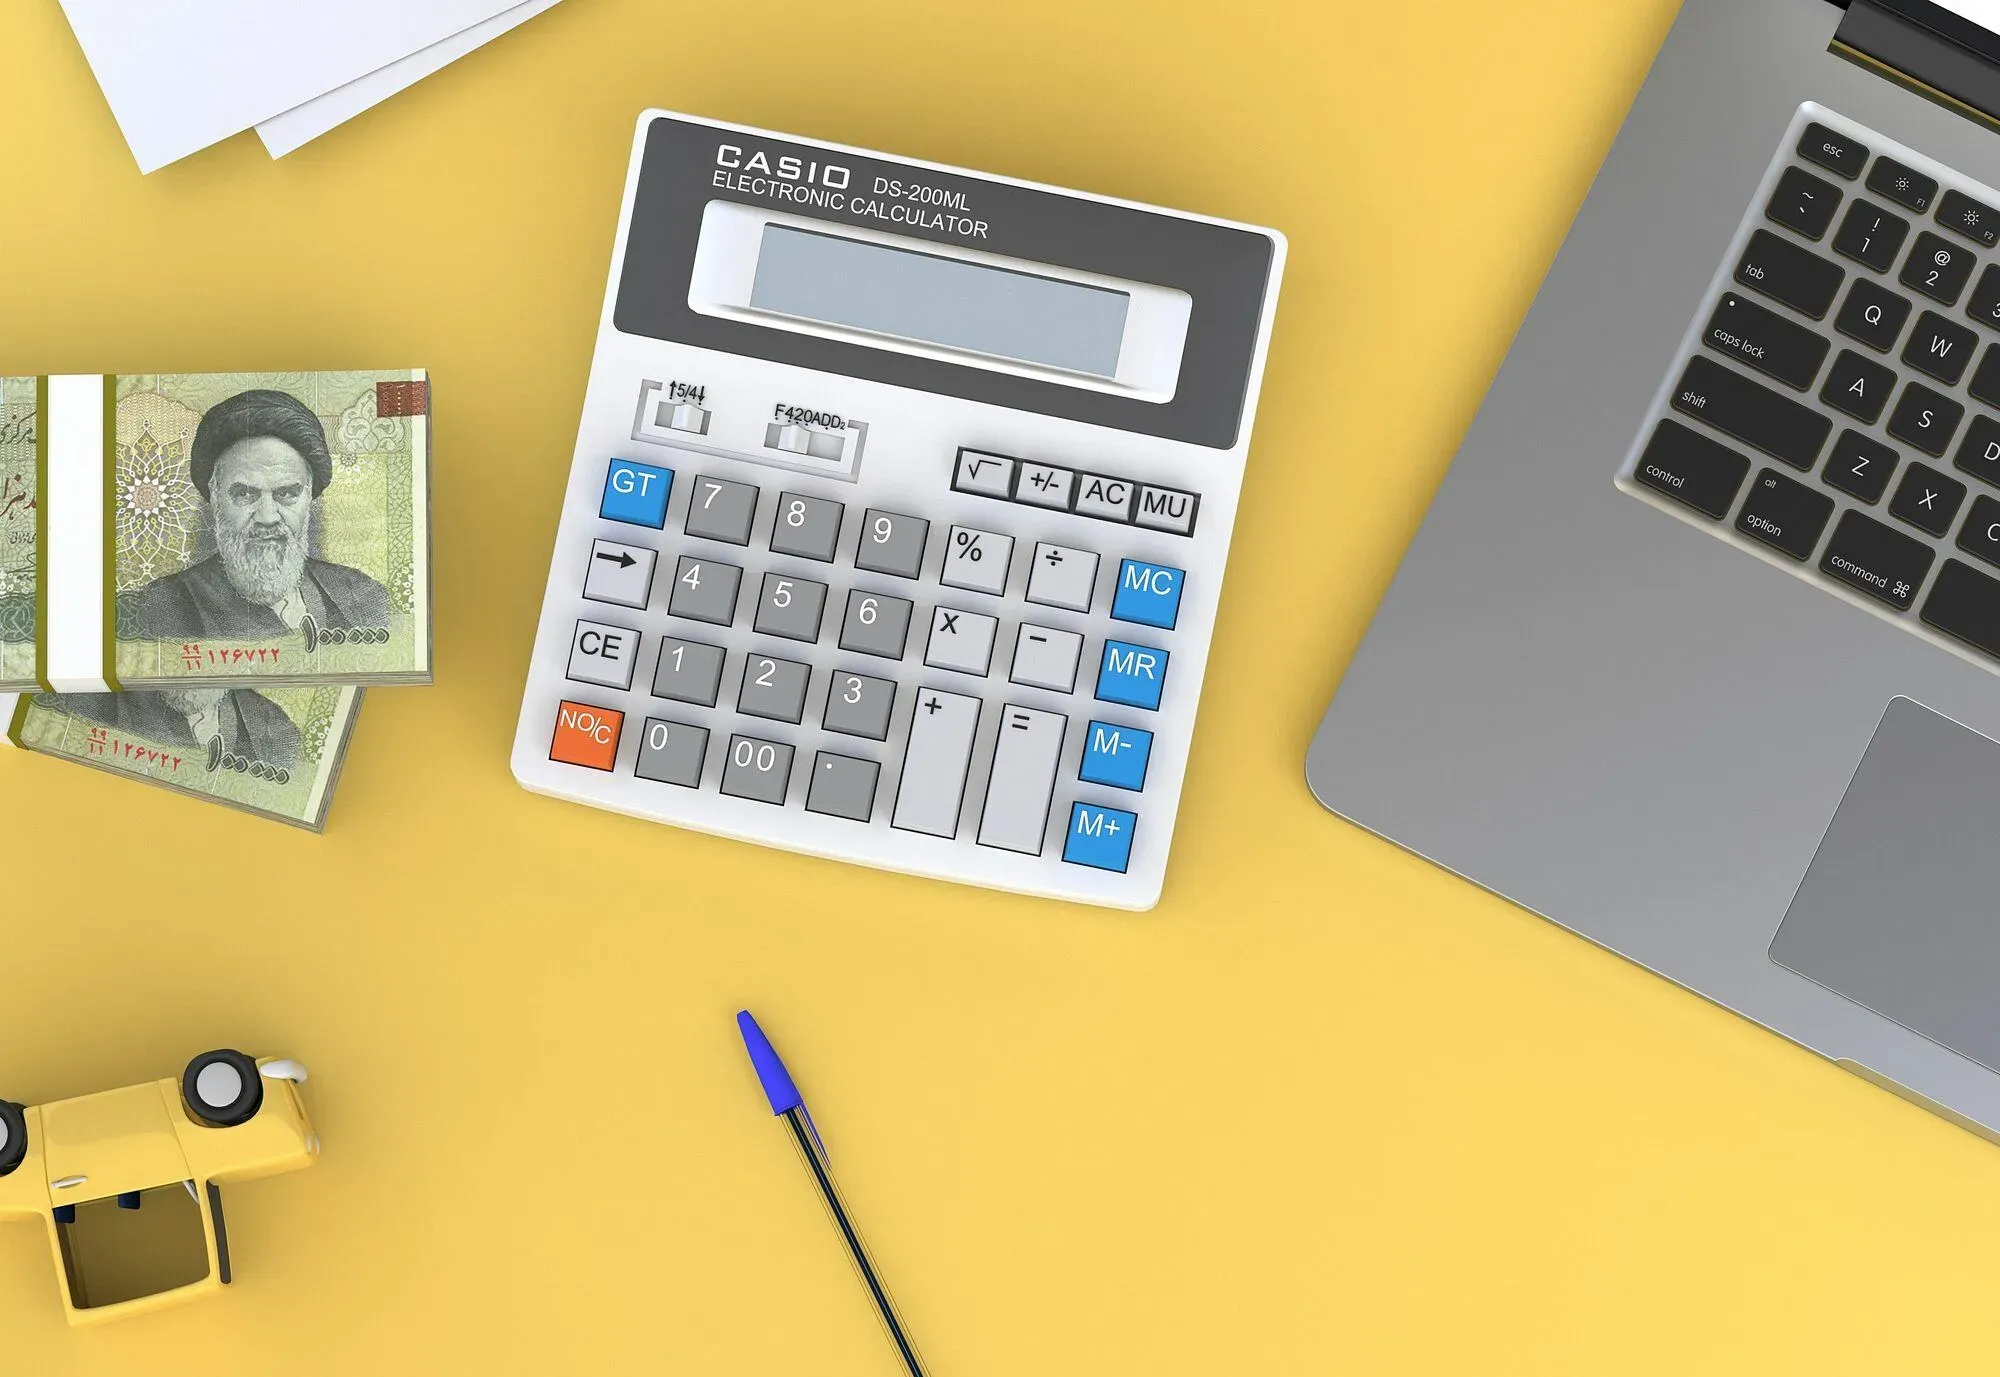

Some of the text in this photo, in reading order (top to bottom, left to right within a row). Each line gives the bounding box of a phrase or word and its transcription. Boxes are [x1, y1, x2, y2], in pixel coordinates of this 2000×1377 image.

[1822, 143, 1843, 158] esc
[716, 143, 972, 212] CASIO DS-200ML
[711, 169, 989, 239] ELECTRONIC CALCULATOR
[1861, 237, 1871, 253] 1
[1934, 250, 1951, 267] @
[1745, 263, 1765, 280] tab
[1925, 270, 1939, 287] 2
[1864, 305, 1882, 326] Q
[1713, 329, 1765, 359] caps lock
[1930, 335, 1953, 358] W
[1681, 391, 1706, 409] shift
[1848, 377, 1864, 397] A
[1917, 410, 1934, 428] S
[1983, 441, 2000, 461] D
[1646, 465, 1685, 489] control
[1851, 455, 1870, 477] Z
[612, 468, 657, 497] GT
[704, 482, 723, 509] 7
[1084, 478, 1127, 506] AC
[1764, 479, 1777, 489] alt
[1142, 490, 1188, 520] MU
[1918, 488, 1938, 511] X
[787, 500, 806, 527] 8
[1747, 514, 1782, 537] option
[873, 517, 892, 544] 9
[956, 531, 982, 562] %
[681, 564, 701, 590] 4
[1124, 564, 1174, 596] MC
[1830, 554, 1889, 589] command
[773, 580, 794, 608] 5
[859, 598, 879, 625] 6
[579, 630, 622, 661] CE
[672, 646, 684, 672] 1
[755, 659, 776, 687] 2
[1108, 648, 1156, 681] MR
[843, 677, 863, 704] 3
[649, 723, 668, 751] 0
[1093, 728, 1133, 756] M-
[734, 740, 775, 772] 00
[1078, 810, 1122, 837] M+
